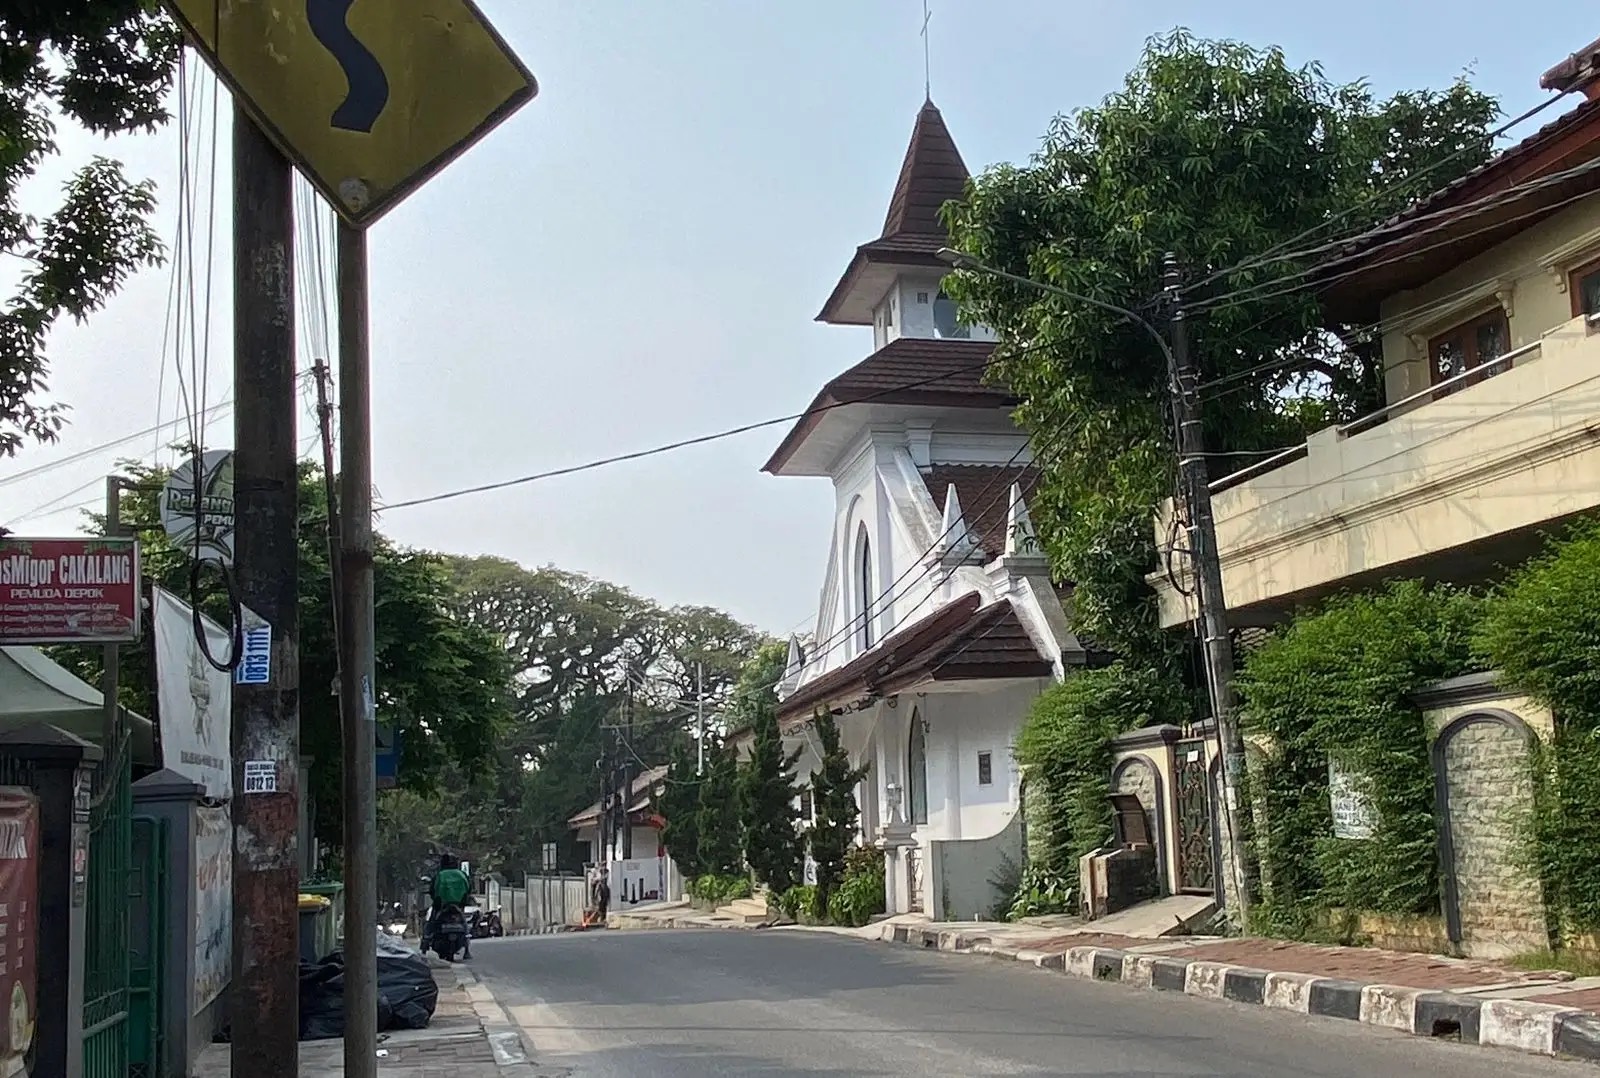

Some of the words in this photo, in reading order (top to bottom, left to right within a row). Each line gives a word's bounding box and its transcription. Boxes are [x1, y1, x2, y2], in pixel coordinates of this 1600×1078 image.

[204, 514, 234, 525] PEMU
[0, 555, 55, 587] sMigor
[60, 555, 130, 584] CAKALANG
[10, 588, 61, 599] PEMUDA
[65, 588, 104, 599] DEPOK
[245, 654, 268, 680] 0813
